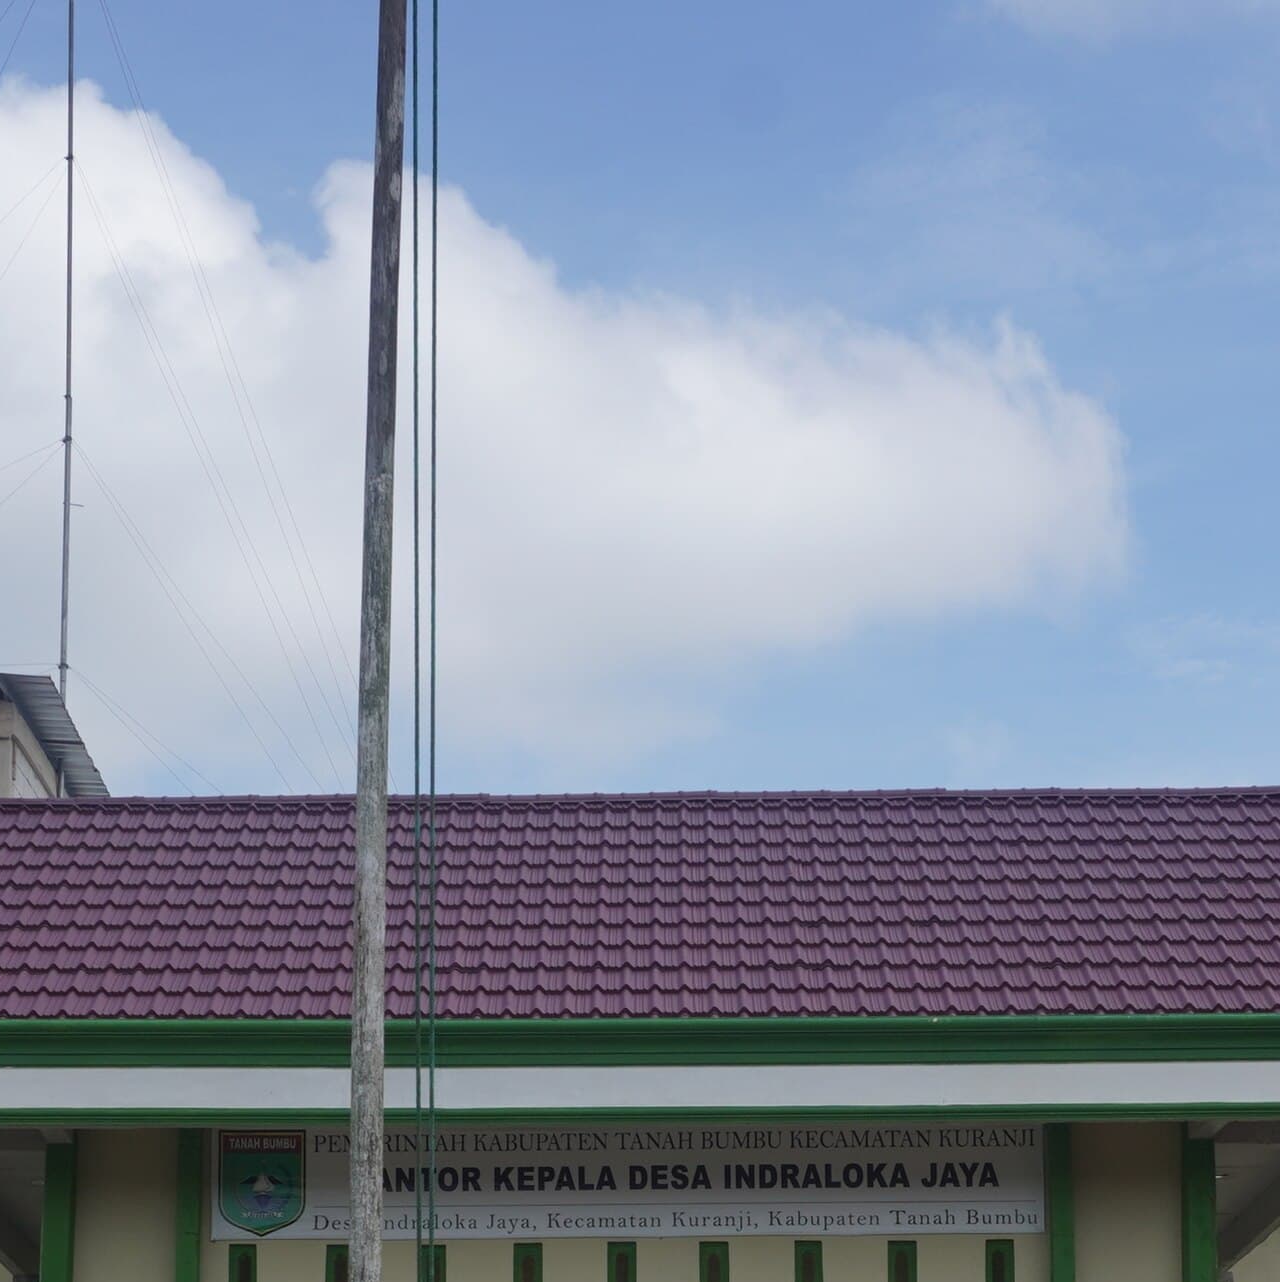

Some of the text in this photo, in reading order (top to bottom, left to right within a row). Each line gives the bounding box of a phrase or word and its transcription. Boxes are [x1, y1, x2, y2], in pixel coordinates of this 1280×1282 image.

[229, 1136, 297, 1149] TANAH BUMBU
[474, 1132, 609, 1152] KABUPATEN
[615, 1131, 693, 1151] TANAH
[701, 1130, 783, 1150] BUMBU
[790, 1129, 932, 1149] KECAMATAN
[939, 1128, 1035, 1148] KURANJI
[383, 1162, 1000, 1193] ANTOR KEPALA DESA INDRALOKA JAYA
[313, 1207, 1040, 1235] Des ndraloka Jaya, Kecamatan Kuranji, Kabupaten Tanah Bumbu
